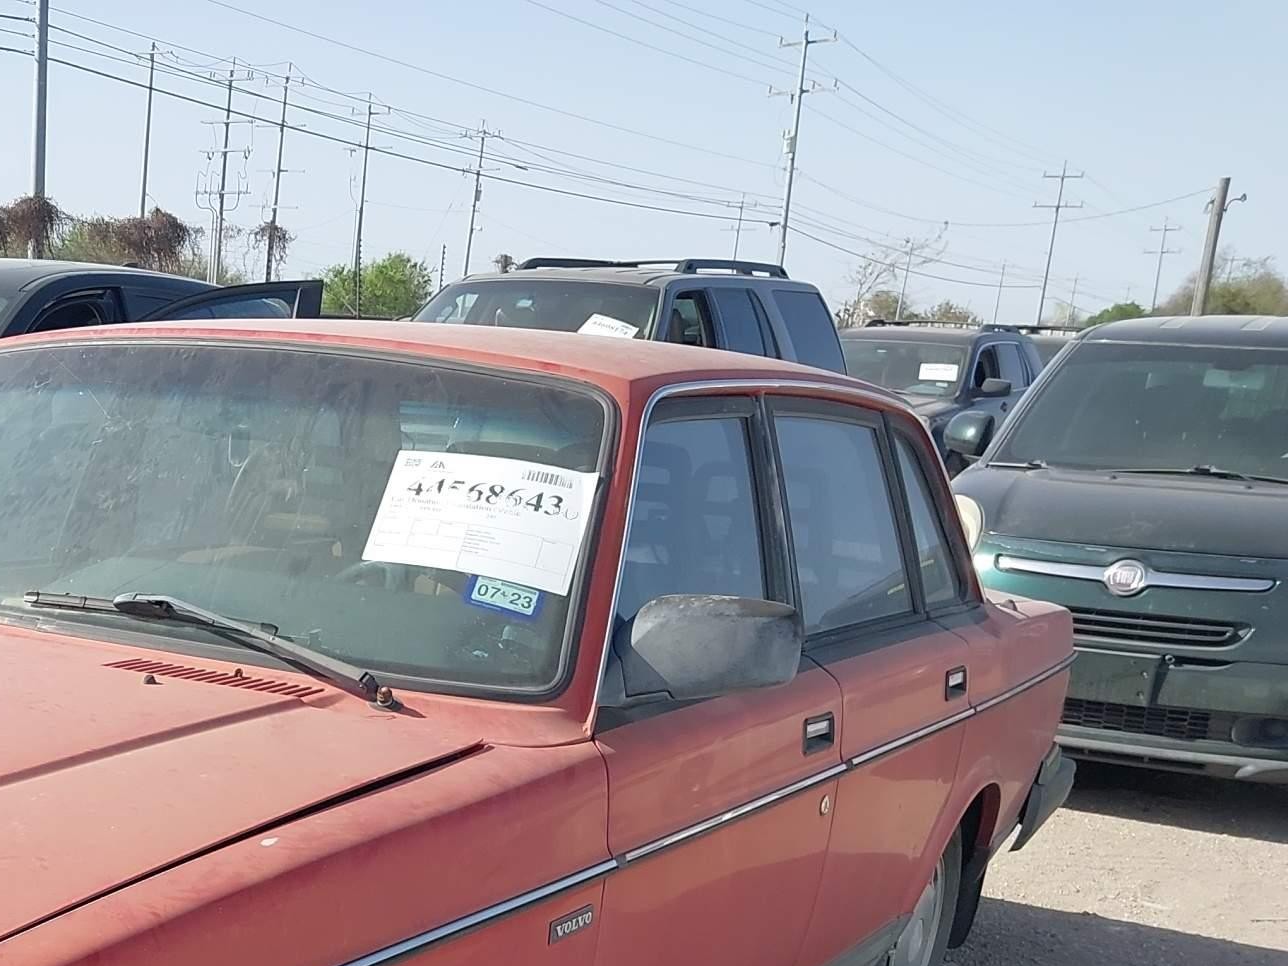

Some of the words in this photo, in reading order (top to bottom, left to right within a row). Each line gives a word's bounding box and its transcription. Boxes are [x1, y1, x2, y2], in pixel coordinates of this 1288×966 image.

[477, 583, 502, 600] 07
[509, 592, 533, 609] 23
[556, 911, 592, 937] VOLVO
